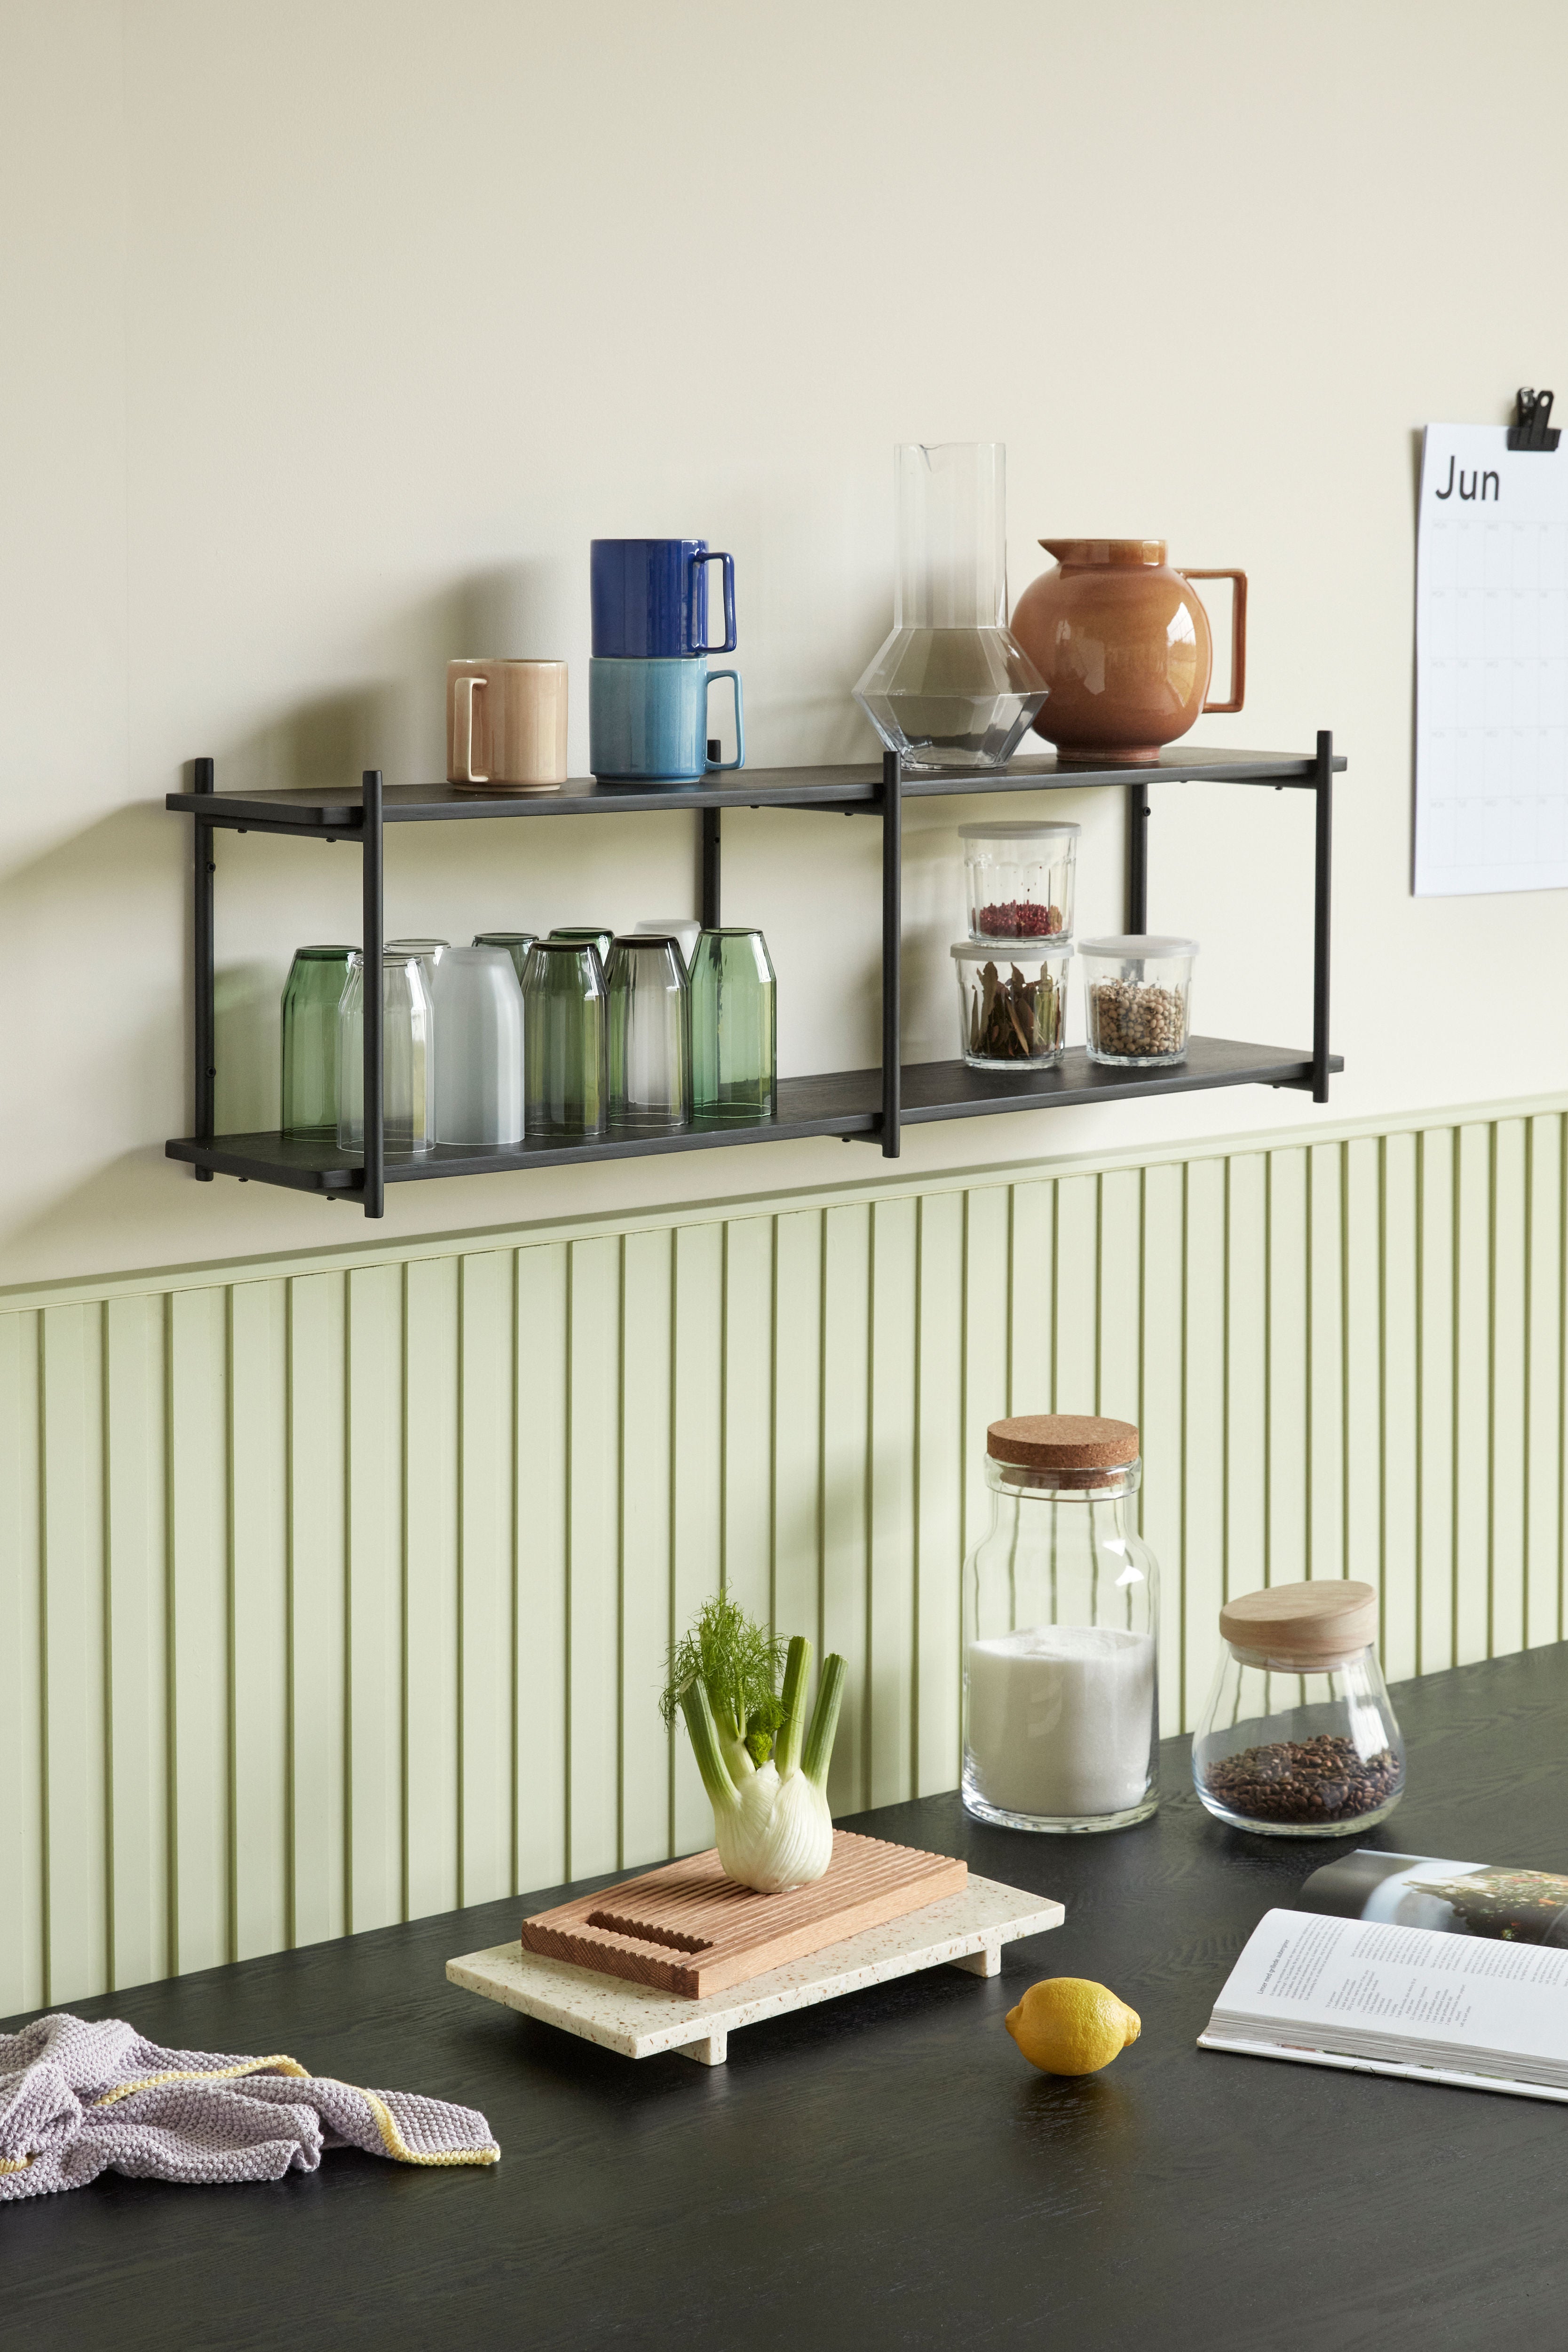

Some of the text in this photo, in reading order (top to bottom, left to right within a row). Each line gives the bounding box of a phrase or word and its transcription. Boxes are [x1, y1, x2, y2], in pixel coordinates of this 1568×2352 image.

[1436, 456, 1498, 500] Jun
[1257, 1983, 1267, 1994] Linser
[1269, 1959, 1280, 1973] grillede
[1276, 1939, 1290, 1958] auberginer
